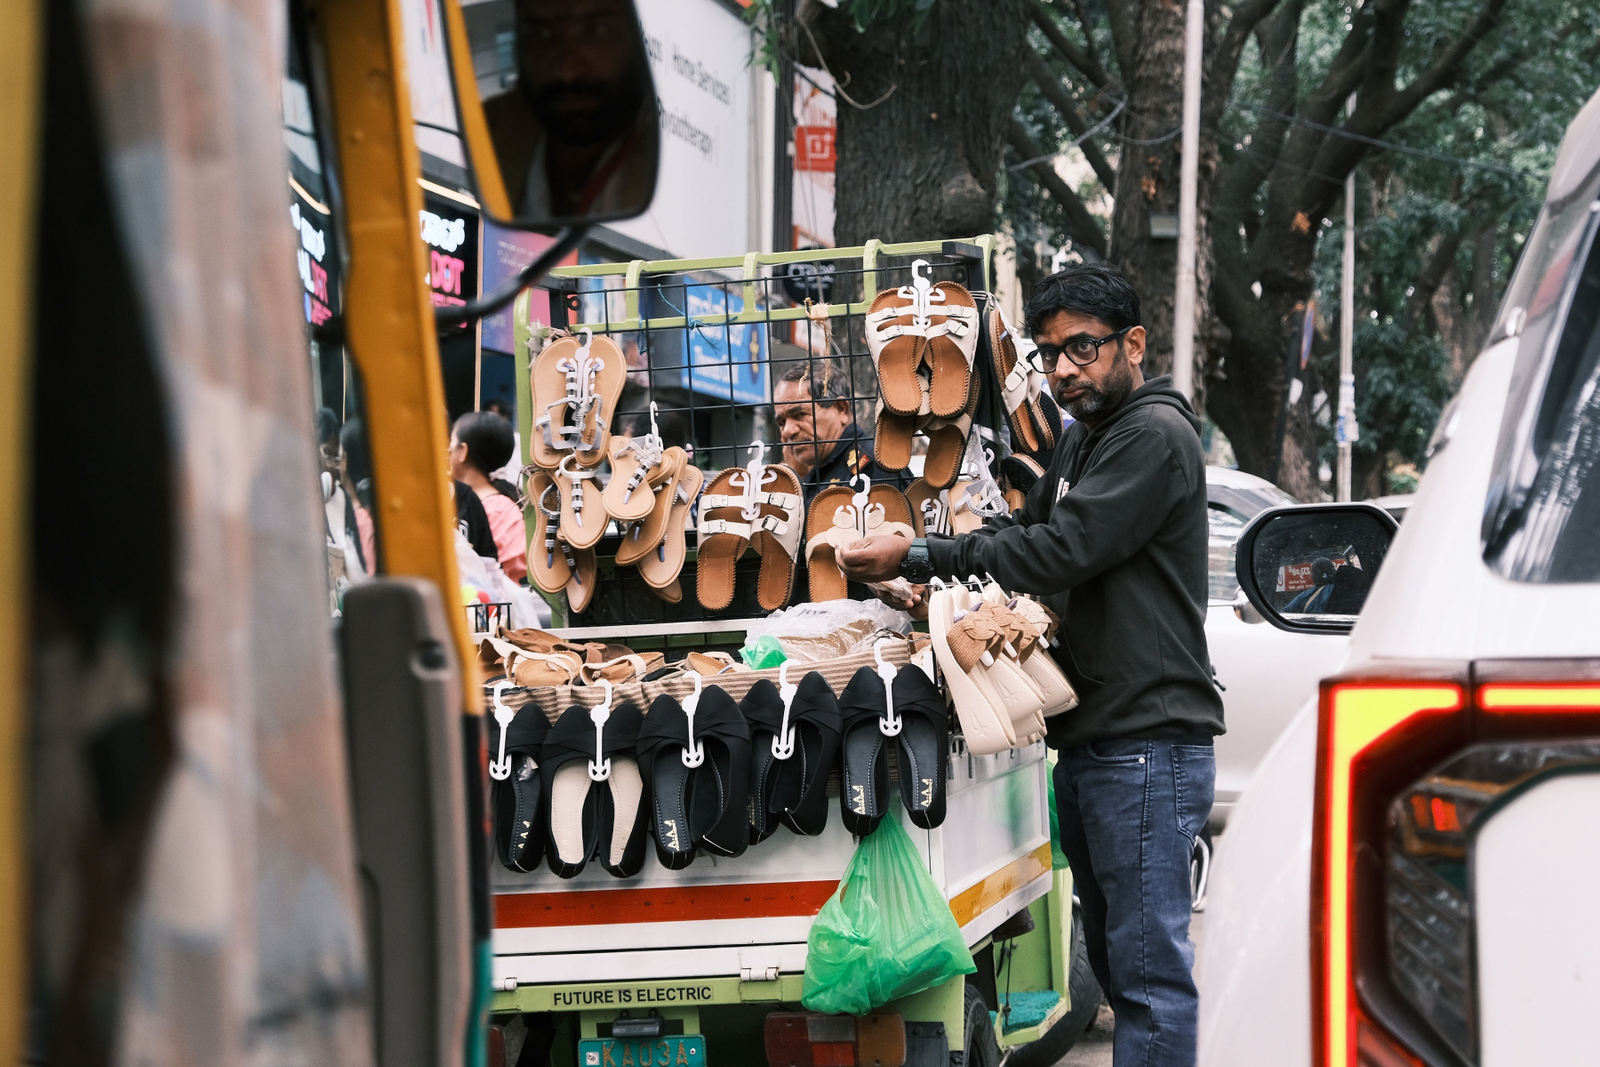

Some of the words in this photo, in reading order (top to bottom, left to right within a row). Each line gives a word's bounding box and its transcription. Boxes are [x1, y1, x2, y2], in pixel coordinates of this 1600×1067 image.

[671, 43, 698, 83] Home
[697, 60, 730, 106] Services
[553, 990, 614, 1006] FUTURE
[618, 989, 632, 1003] IS
[637, 986, 711, 1002] ELECTRIC
